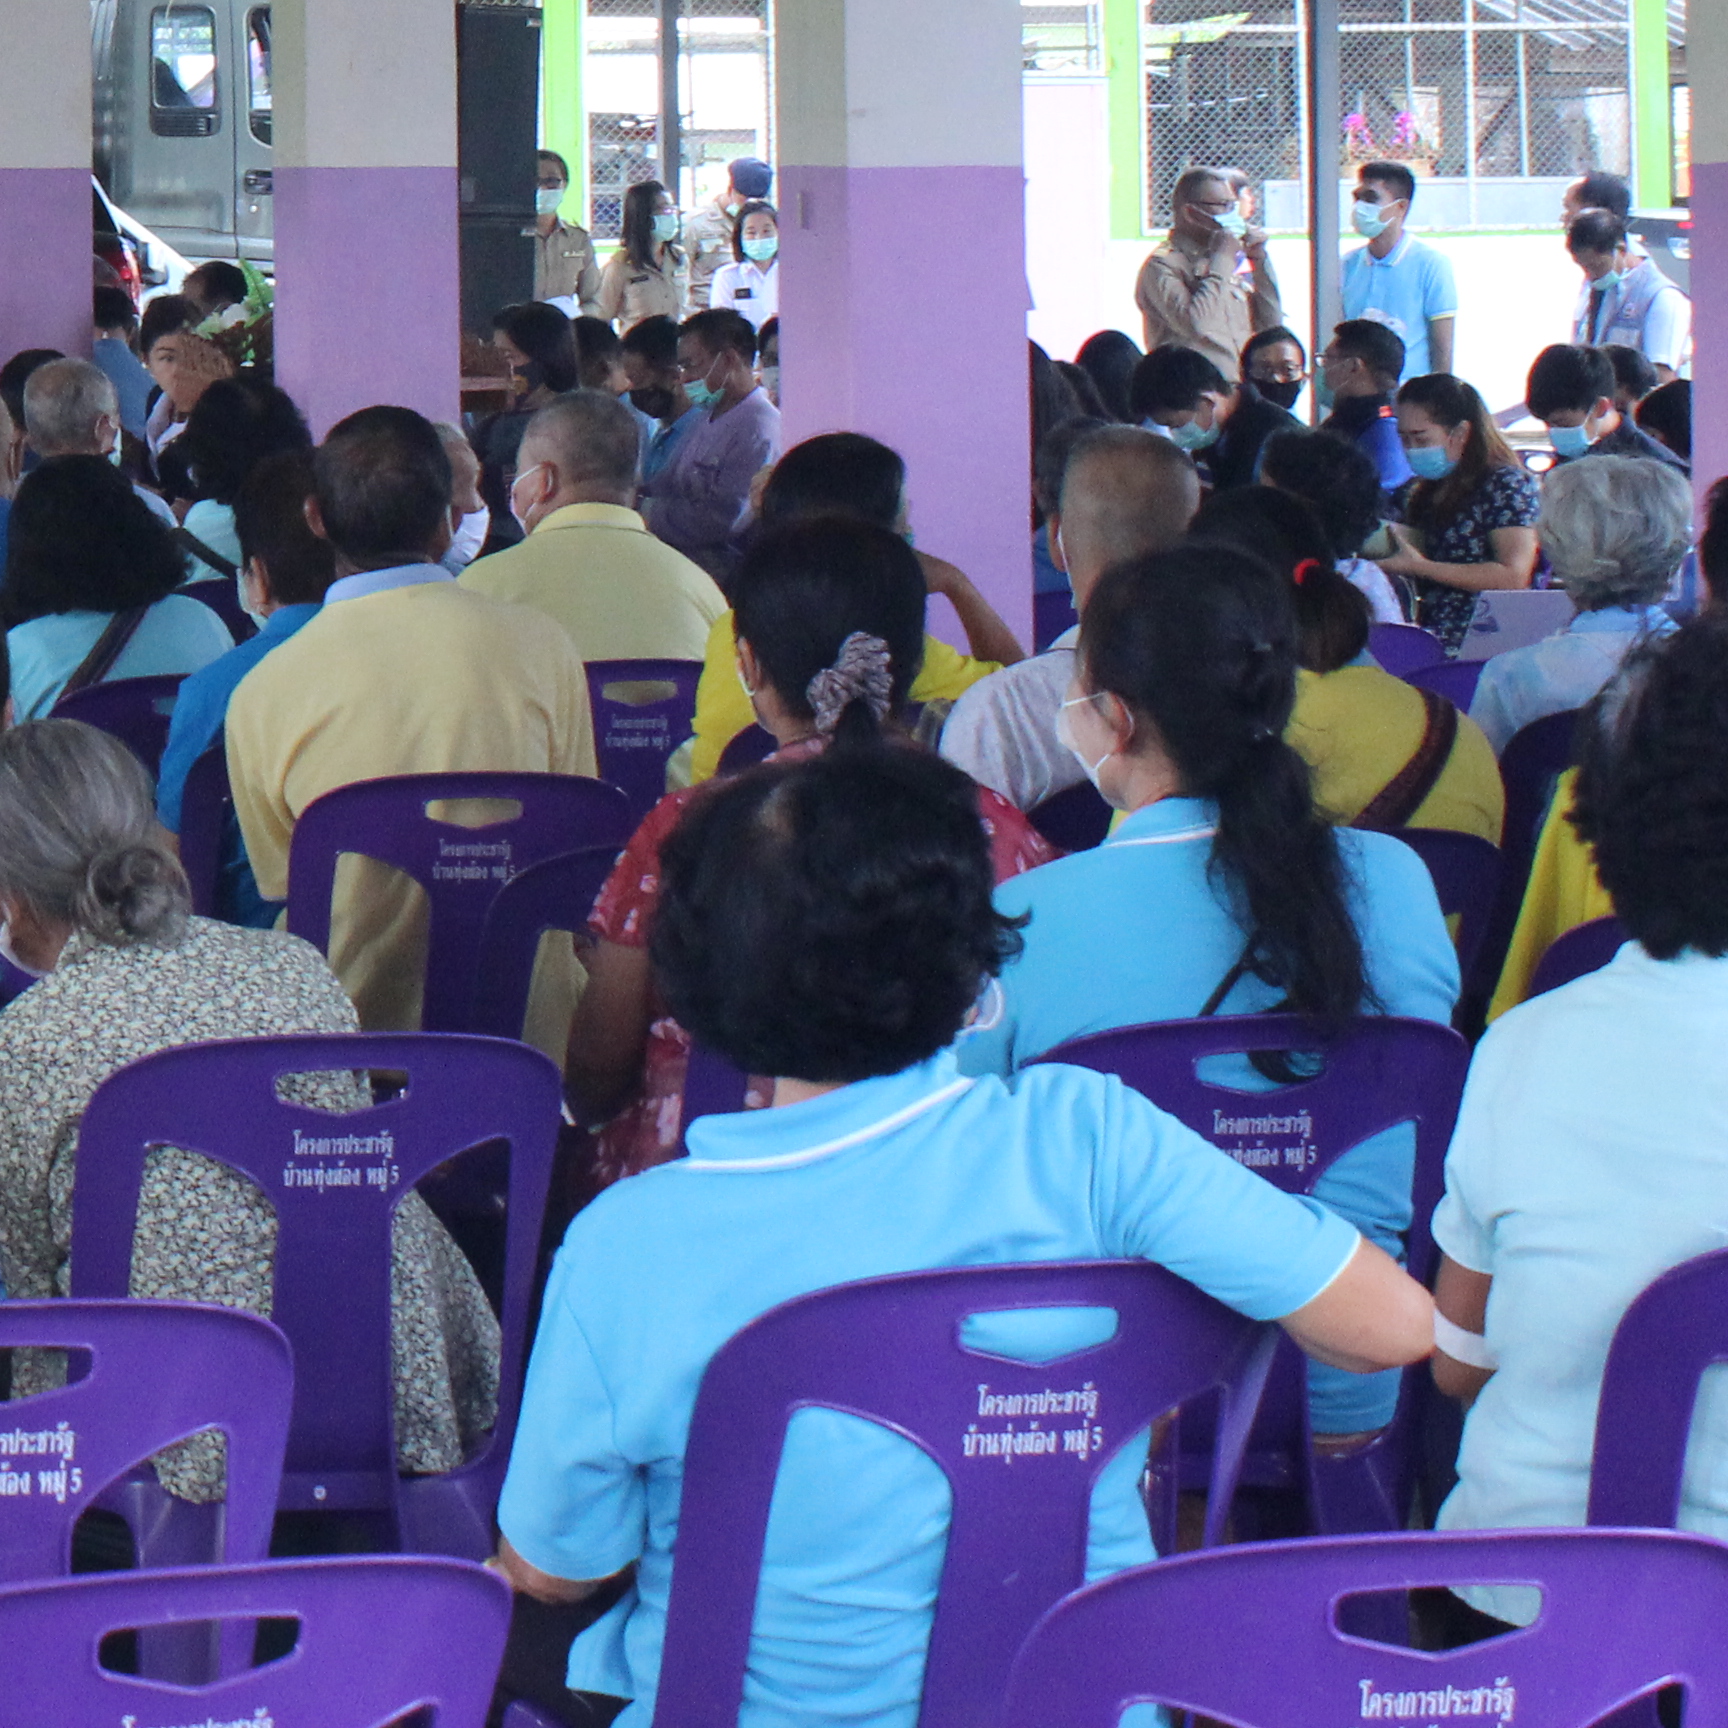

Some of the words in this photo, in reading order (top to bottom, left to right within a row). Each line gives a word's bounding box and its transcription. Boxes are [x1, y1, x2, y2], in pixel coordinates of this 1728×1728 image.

[293, 1129, 393, 1159] โครงการประชารัฐ
[390, 1165, 399, 1185] 5
[977, 1381, 1099, 1419] โครงการประชารัฐ
[1091, 1425, 1103, 1451] 5
[70, 1467, 82, 1493] 5
[1358, 1676, 1516, 1721] โครงการประชารัฐ
